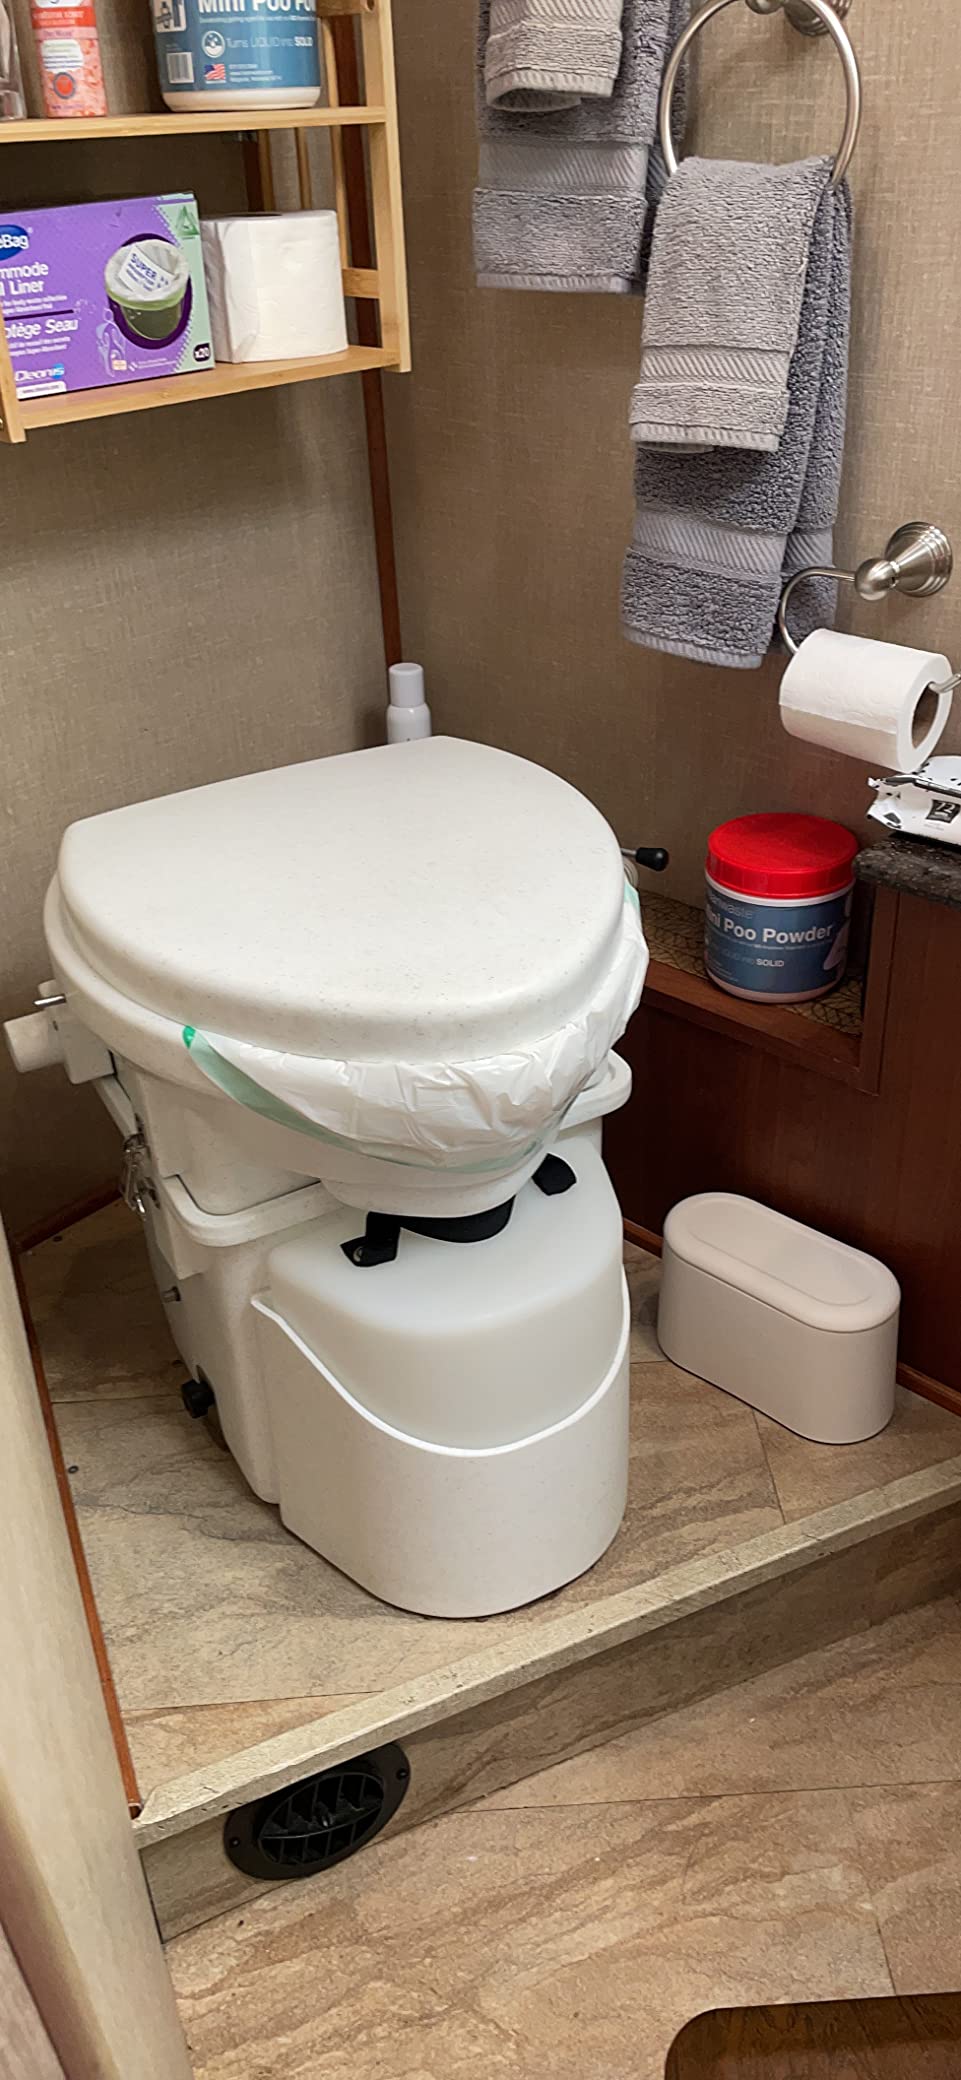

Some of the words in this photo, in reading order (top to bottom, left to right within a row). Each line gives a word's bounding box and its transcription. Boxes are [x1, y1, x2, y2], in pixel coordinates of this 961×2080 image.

[252, 0, 291, 12] Poo
[130, 253, 157, 280] SUPER
[9, 280, 45, 296] Liner
[45, 319, 79, 334] Seau
[723, 917, 757, 941] Poo
[762, 924, 833, 944] Powder
[756, 958, 785, 967] SOLID
